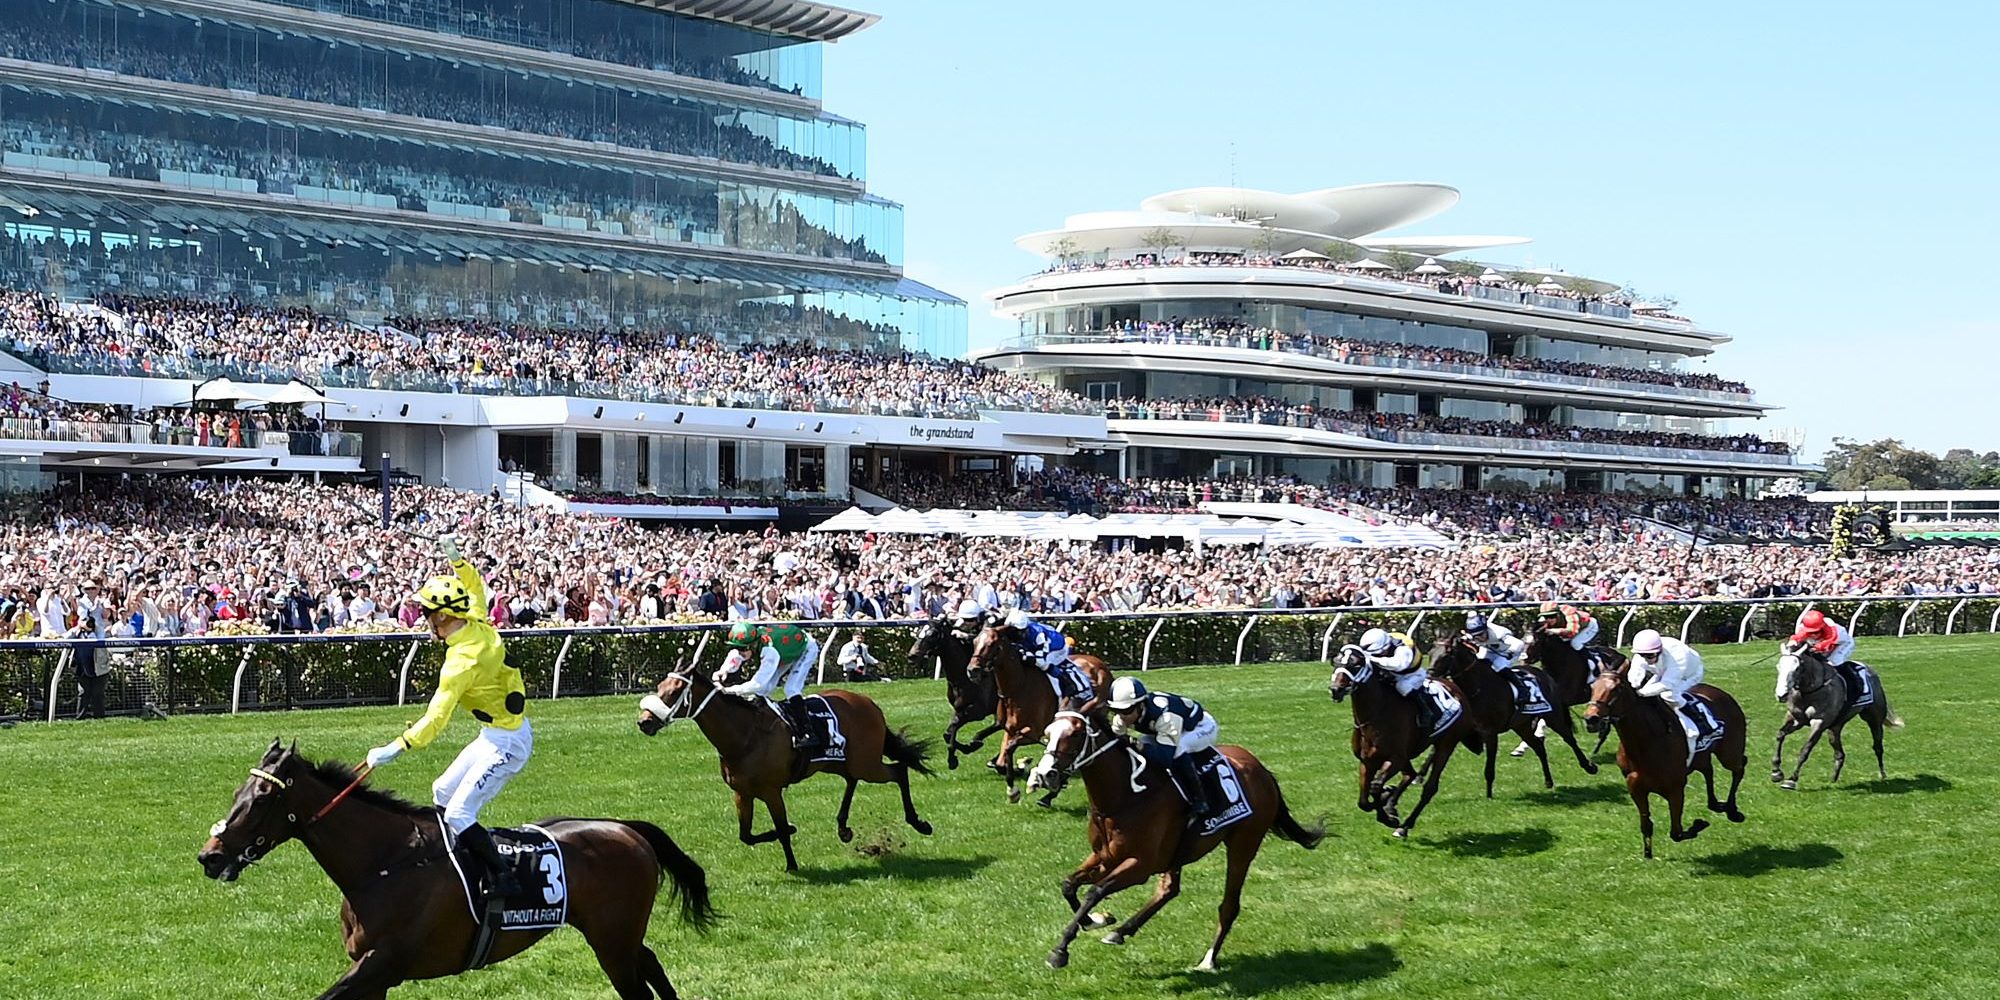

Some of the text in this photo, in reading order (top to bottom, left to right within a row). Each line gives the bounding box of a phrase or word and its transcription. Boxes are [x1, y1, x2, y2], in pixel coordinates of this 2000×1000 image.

[910, 425, 974, 441] the grandstand
[475, 752, 514, 790] ZAHRA
[1216, 764, 1239, 803] 6
[540, 853, 563, 904] 3
[533, 909, 539, 921] A
[541, 908, 562, 921] FIGHT
